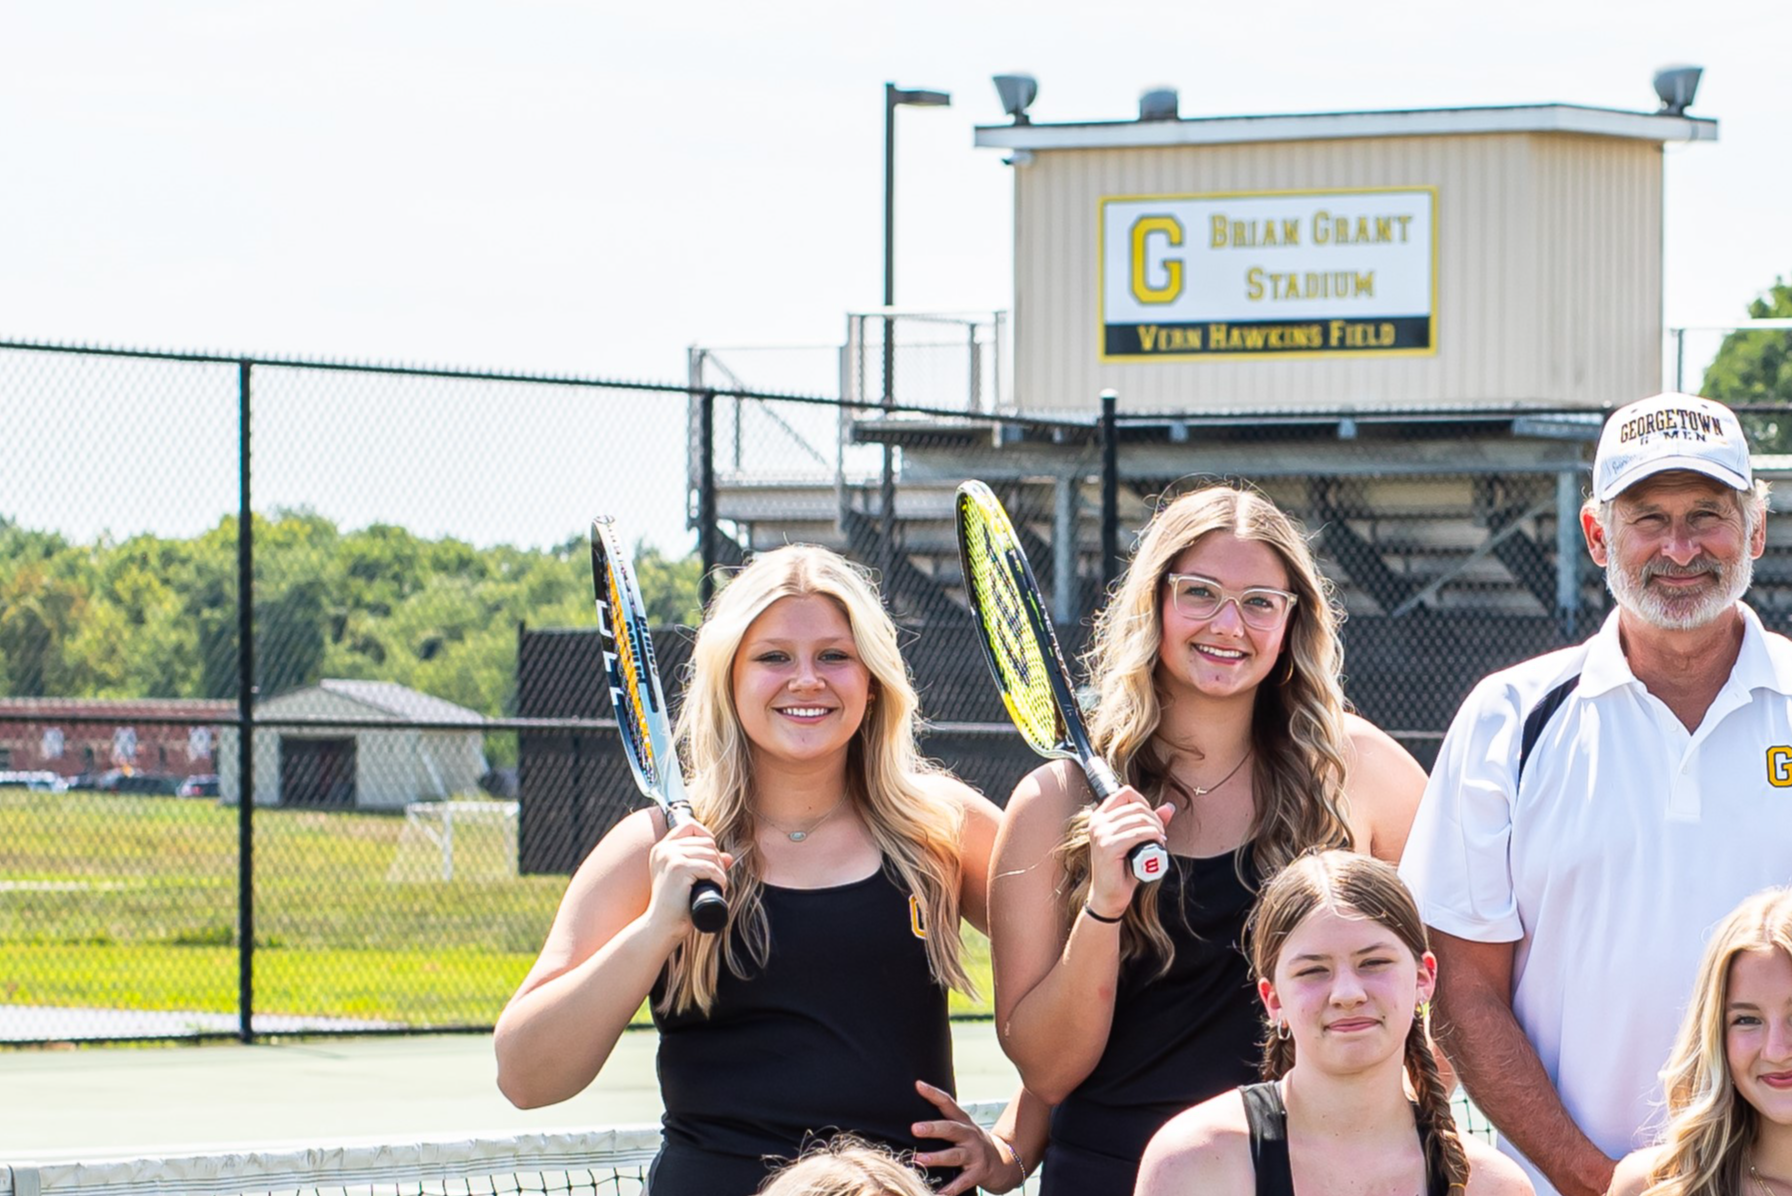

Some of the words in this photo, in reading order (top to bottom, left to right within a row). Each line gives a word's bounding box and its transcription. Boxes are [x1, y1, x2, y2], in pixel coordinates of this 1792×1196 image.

[1210, 212, 1300, 248] BRIAN
[1312, 208, 1412, 246] GRANT
[1129, 214, 1183, 306] G
[1245, 266, 1376, 302] STADIUM
[1137, 323, 1202, 352] VERN
[1208, 320, 1323, 350] HAWKINS
[1328, 317, 1396, 347] FIELD
[1619, 408, 1724, 444] GEORGETOWN
